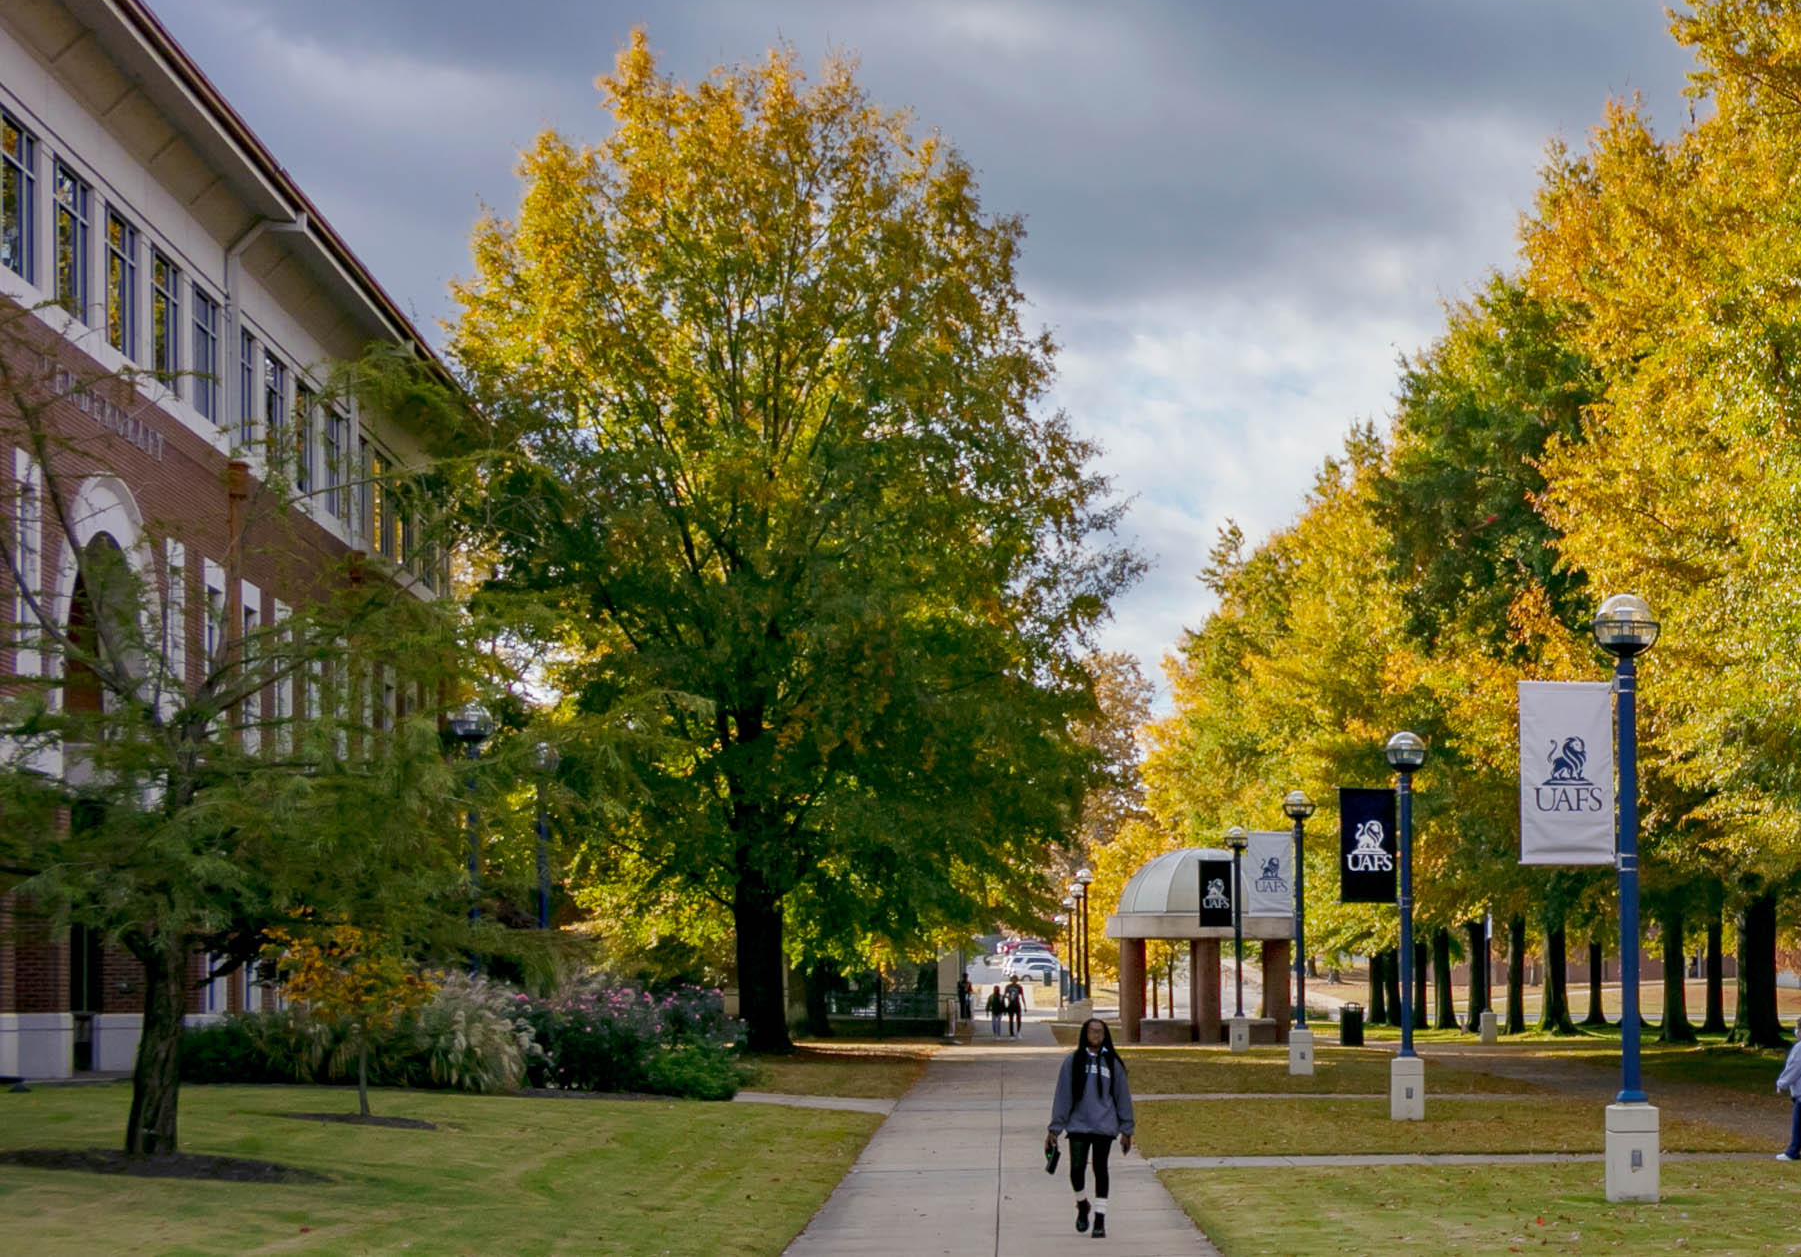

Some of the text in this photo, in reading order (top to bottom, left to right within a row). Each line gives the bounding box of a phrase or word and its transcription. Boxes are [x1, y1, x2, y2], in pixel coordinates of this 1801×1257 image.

[1534, 787, 1603, 812] UAFS
[1346, 853, 1393, 872] UAFS
[1255, 880, 1289, 893] UAFS
[1202, 897, 1230, 910] UAFS
